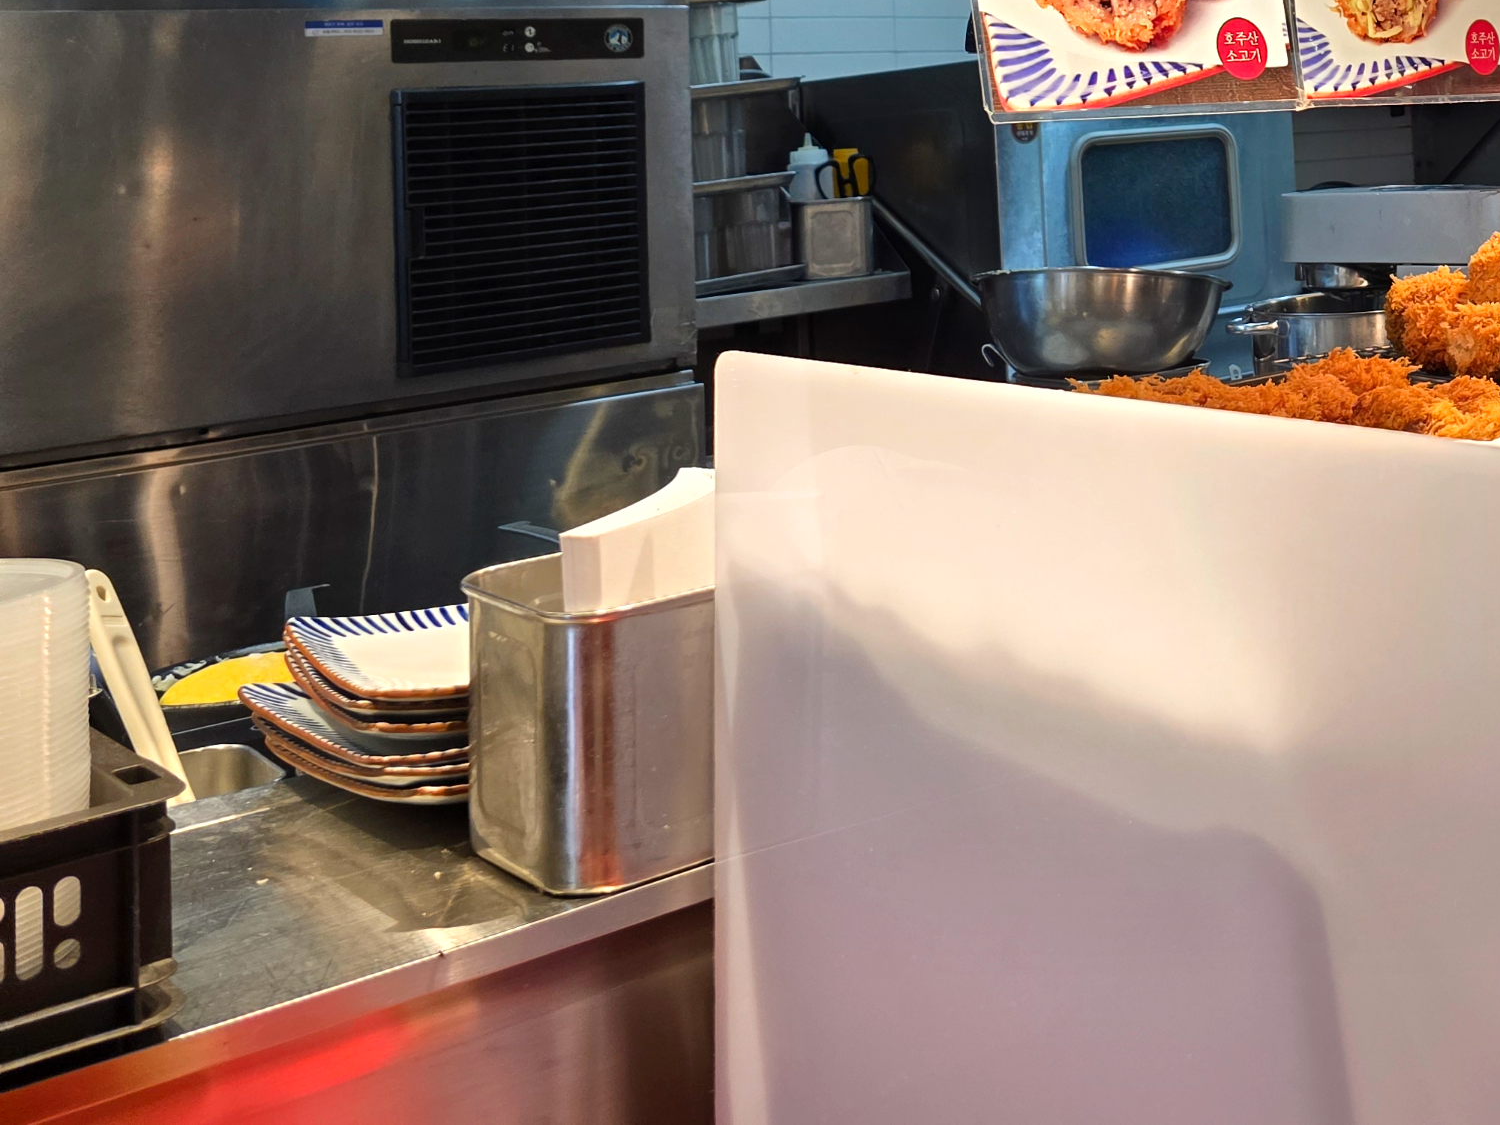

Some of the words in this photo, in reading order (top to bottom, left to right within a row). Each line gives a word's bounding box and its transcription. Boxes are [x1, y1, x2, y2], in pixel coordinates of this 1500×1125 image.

[1224, 31, 1259, 47] 호주산
[1470, 31, 1495, 46] 호주산
[1226, 48, 1262, 63] 소고기
[1471, 47, 1496, 61] 소고기
